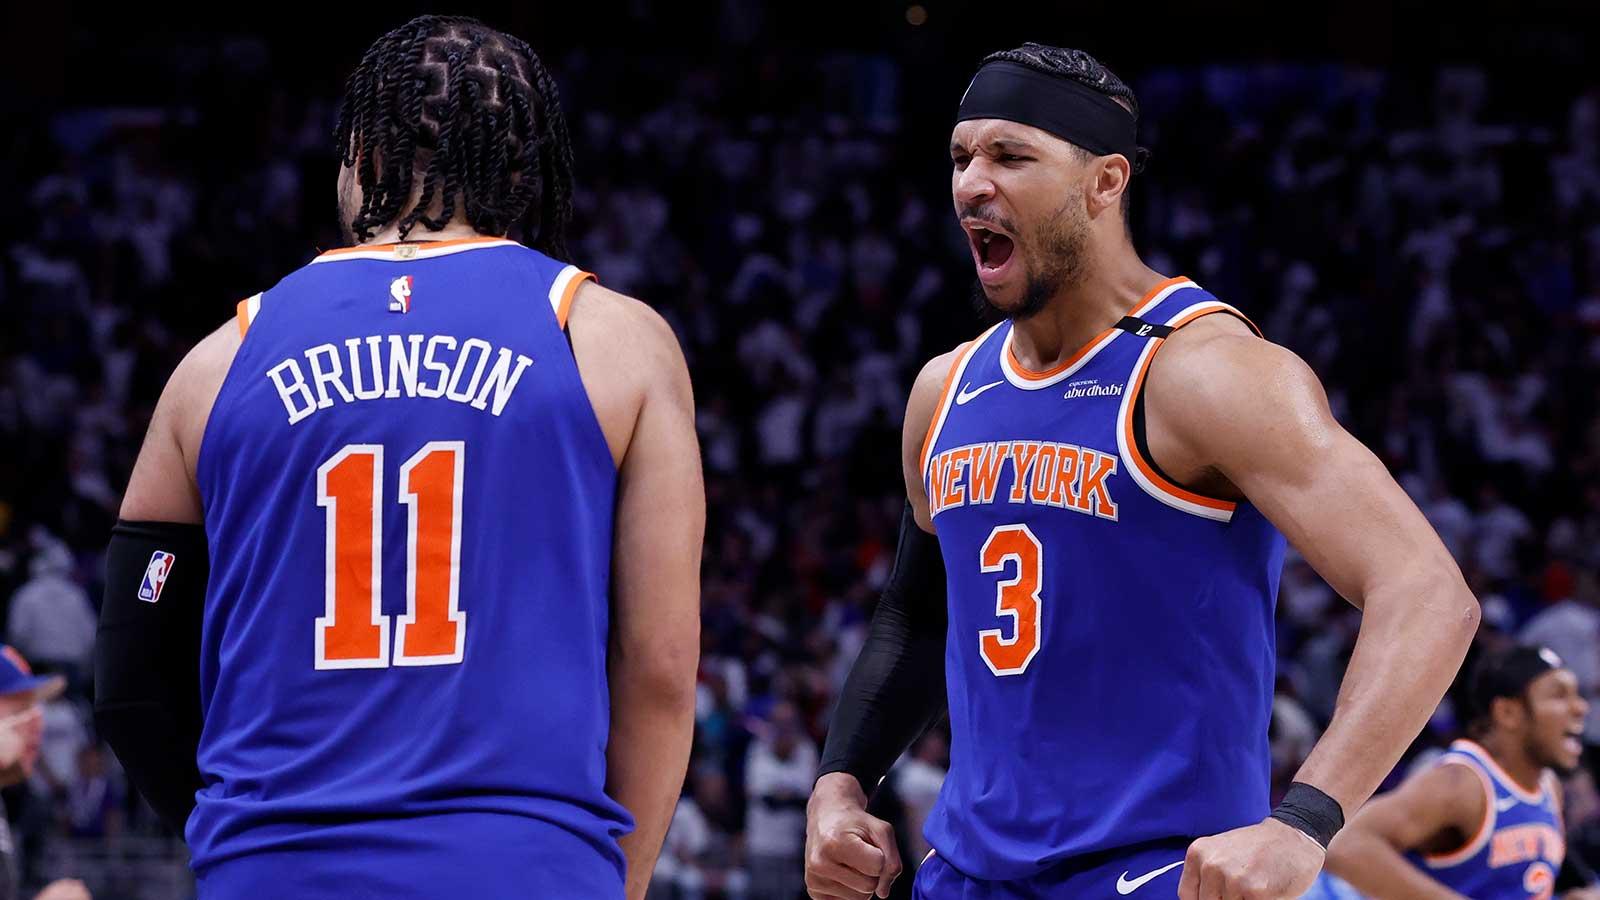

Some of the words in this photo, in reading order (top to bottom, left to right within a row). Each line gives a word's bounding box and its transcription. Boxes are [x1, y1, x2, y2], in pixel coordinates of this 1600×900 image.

[1136, 324, 1153, 336] 12
[266, 334, 533, 425] BRUNSON
[1064, 386, 1086, 399] abu
[1087, 384, 1124, 396] dhabi
[929, 442, 1009, 522] NEW
[1008, 440, 1119, 522] YORK
[314, 441, 466, 670] 11
[979, 523, 1043, 677] 3
